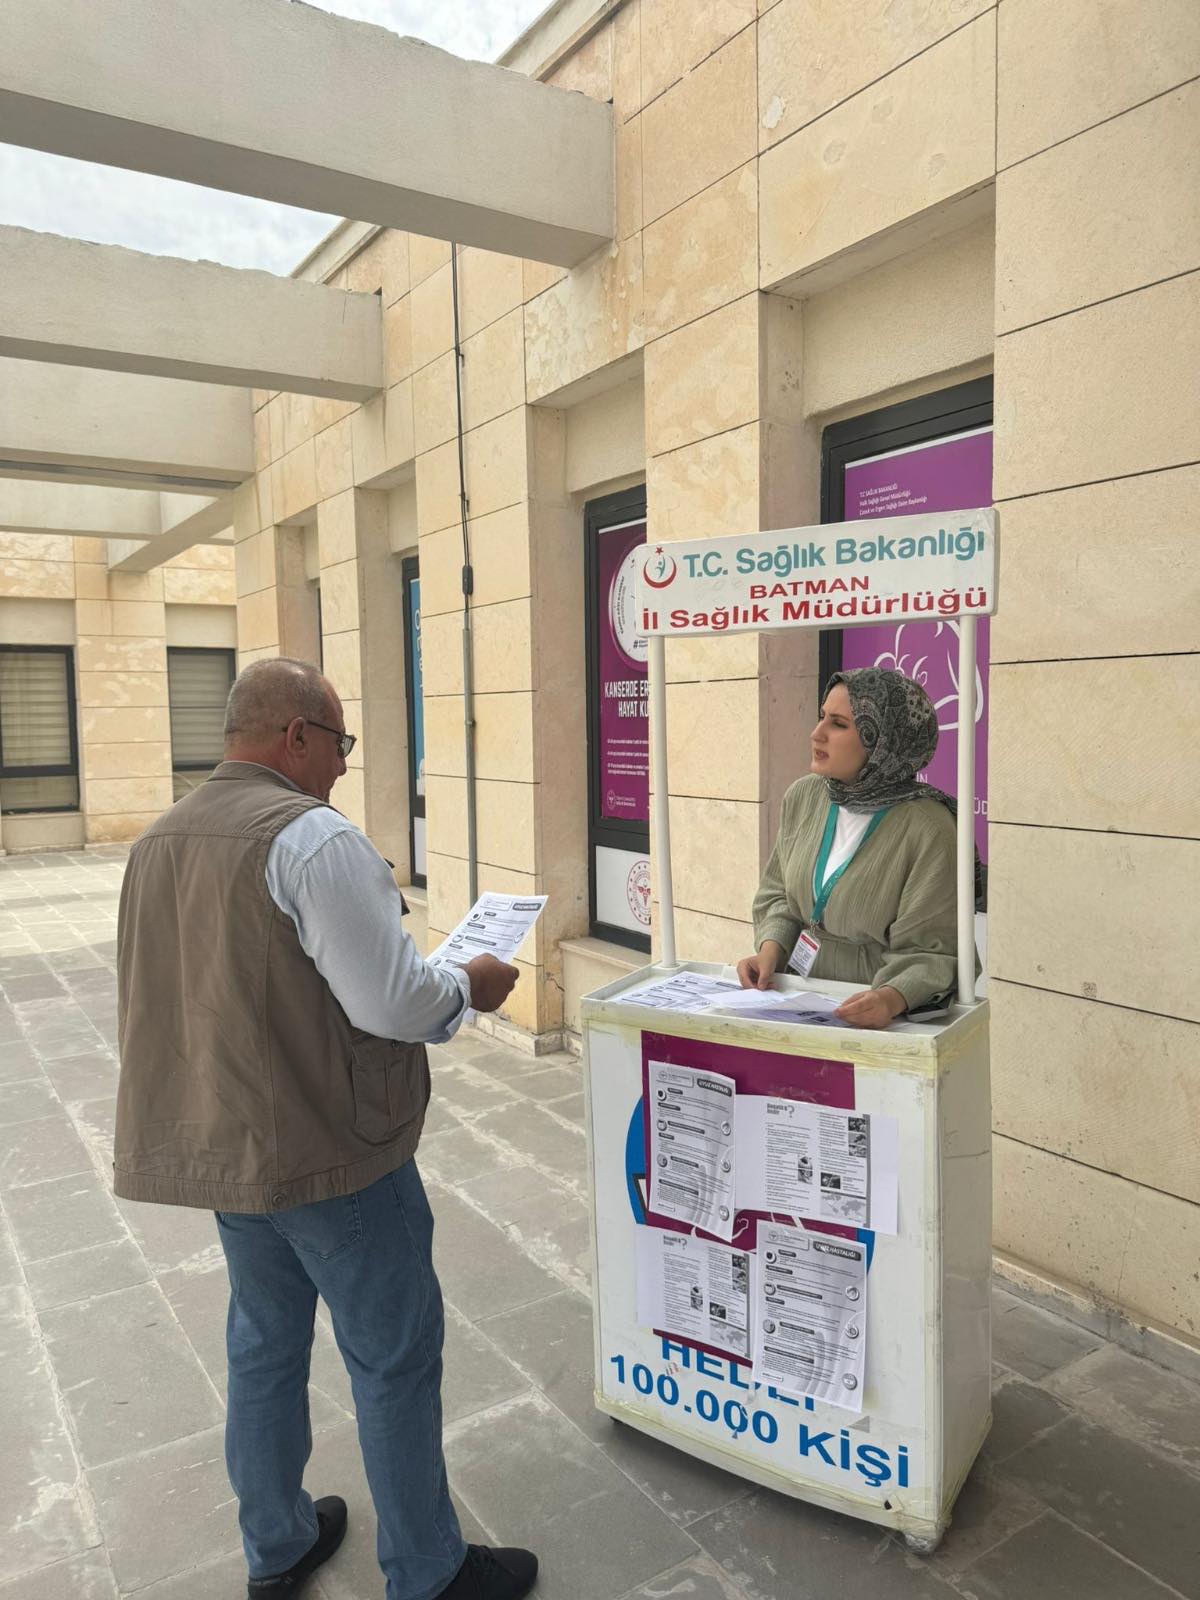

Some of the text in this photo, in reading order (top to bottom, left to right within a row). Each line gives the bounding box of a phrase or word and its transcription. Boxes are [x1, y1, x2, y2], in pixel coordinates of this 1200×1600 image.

[683, 527, 985, 577] T.C. Sağlık Bakanlığı
[750, 576, 870, 599] BATMAN
[643, 587, 987, 631] İl Sağlık Müdürlüğü
[604, 680, 638, 698] KANSERDE
[618, 700, 638, 717] HAYAT
[610, 1354, 909, 1488] 100.000 KİŞİ
